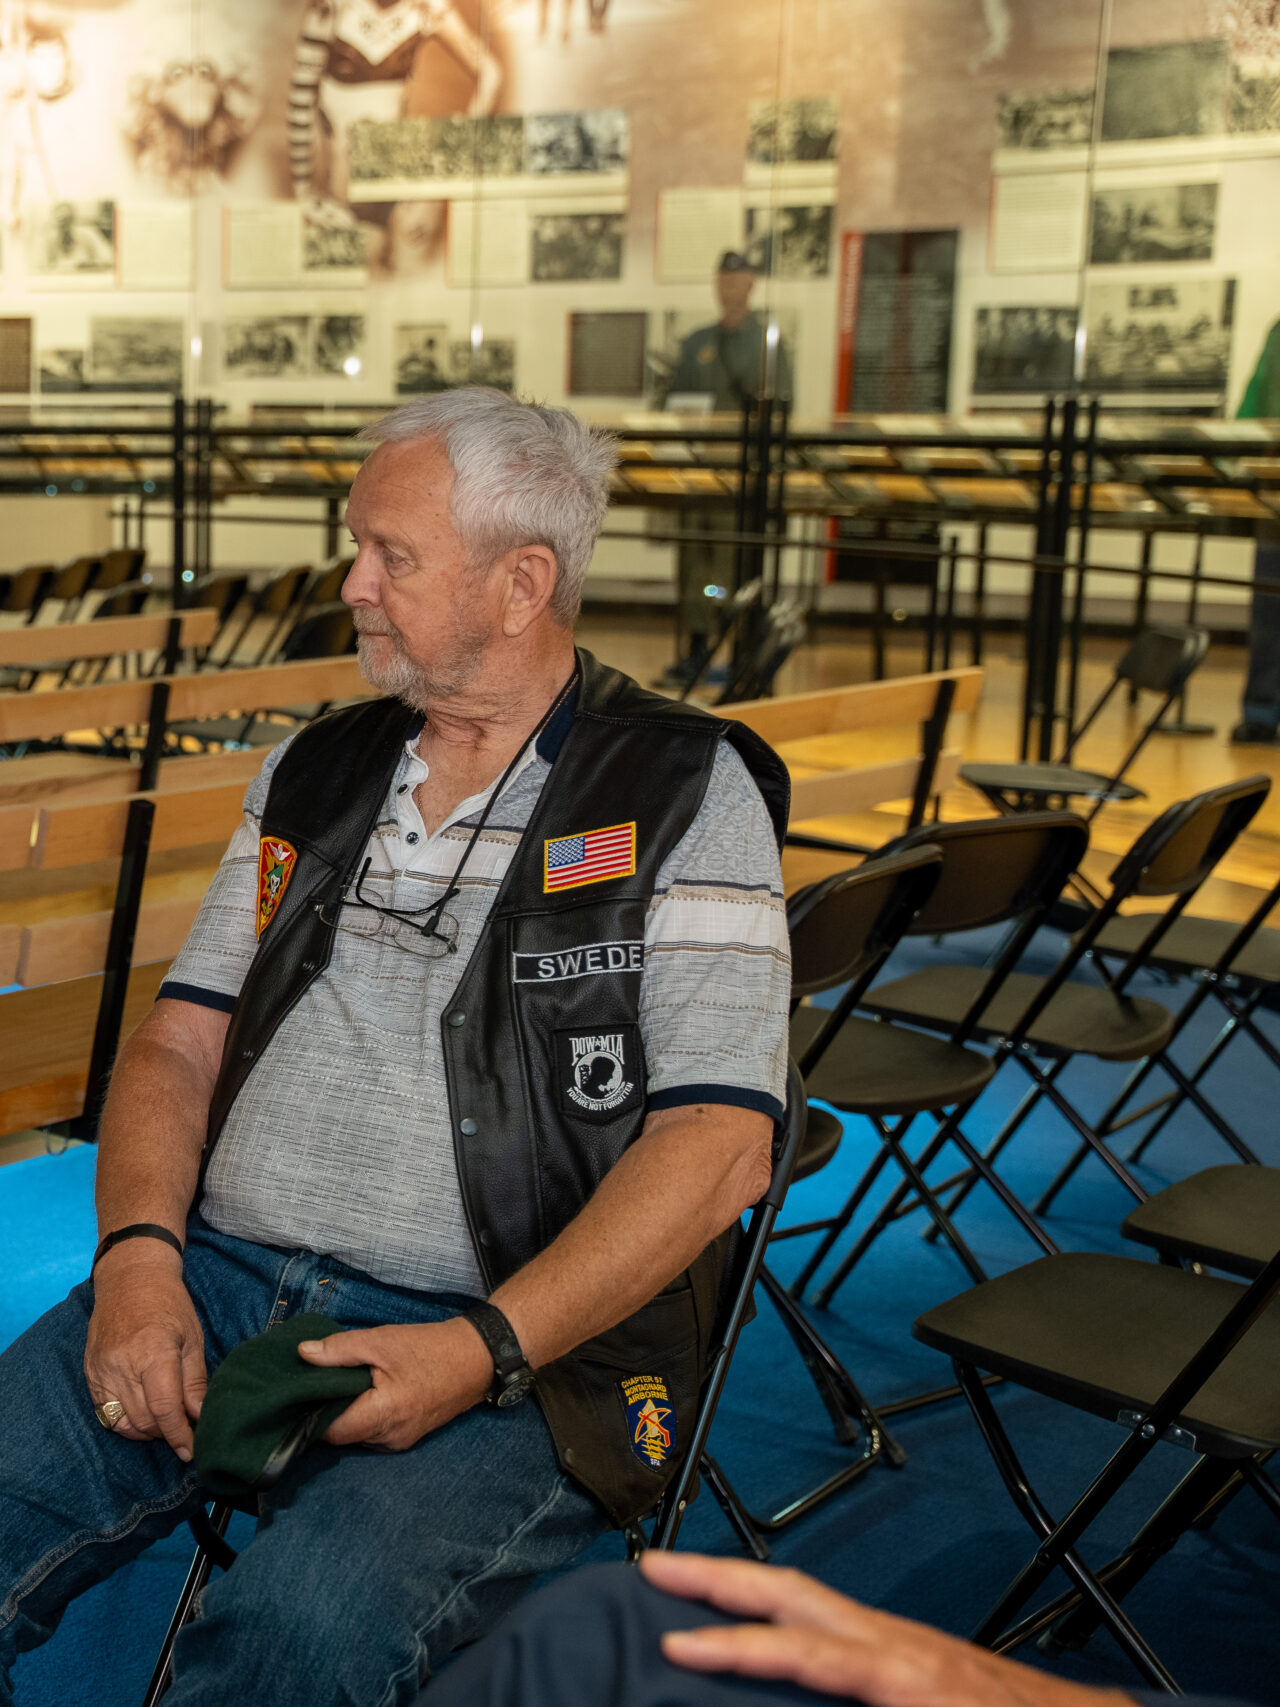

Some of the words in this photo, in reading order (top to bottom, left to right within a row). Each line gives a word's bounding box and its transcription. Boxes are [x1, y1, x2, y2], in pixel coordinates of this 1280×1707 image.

[537, 945, 641, 978] SWEDE
[566, 1086, 578, 1102] YOU
[575, 1097, 589, 1109] ARE
[588, 1102, 602, 1111] NOT
[603, 1082, 635, 1111] FORGOTTEN
[621, 1375, 653, 1389] CHAPTER
[628, 1391, 669, 1406] AIRBORNE
